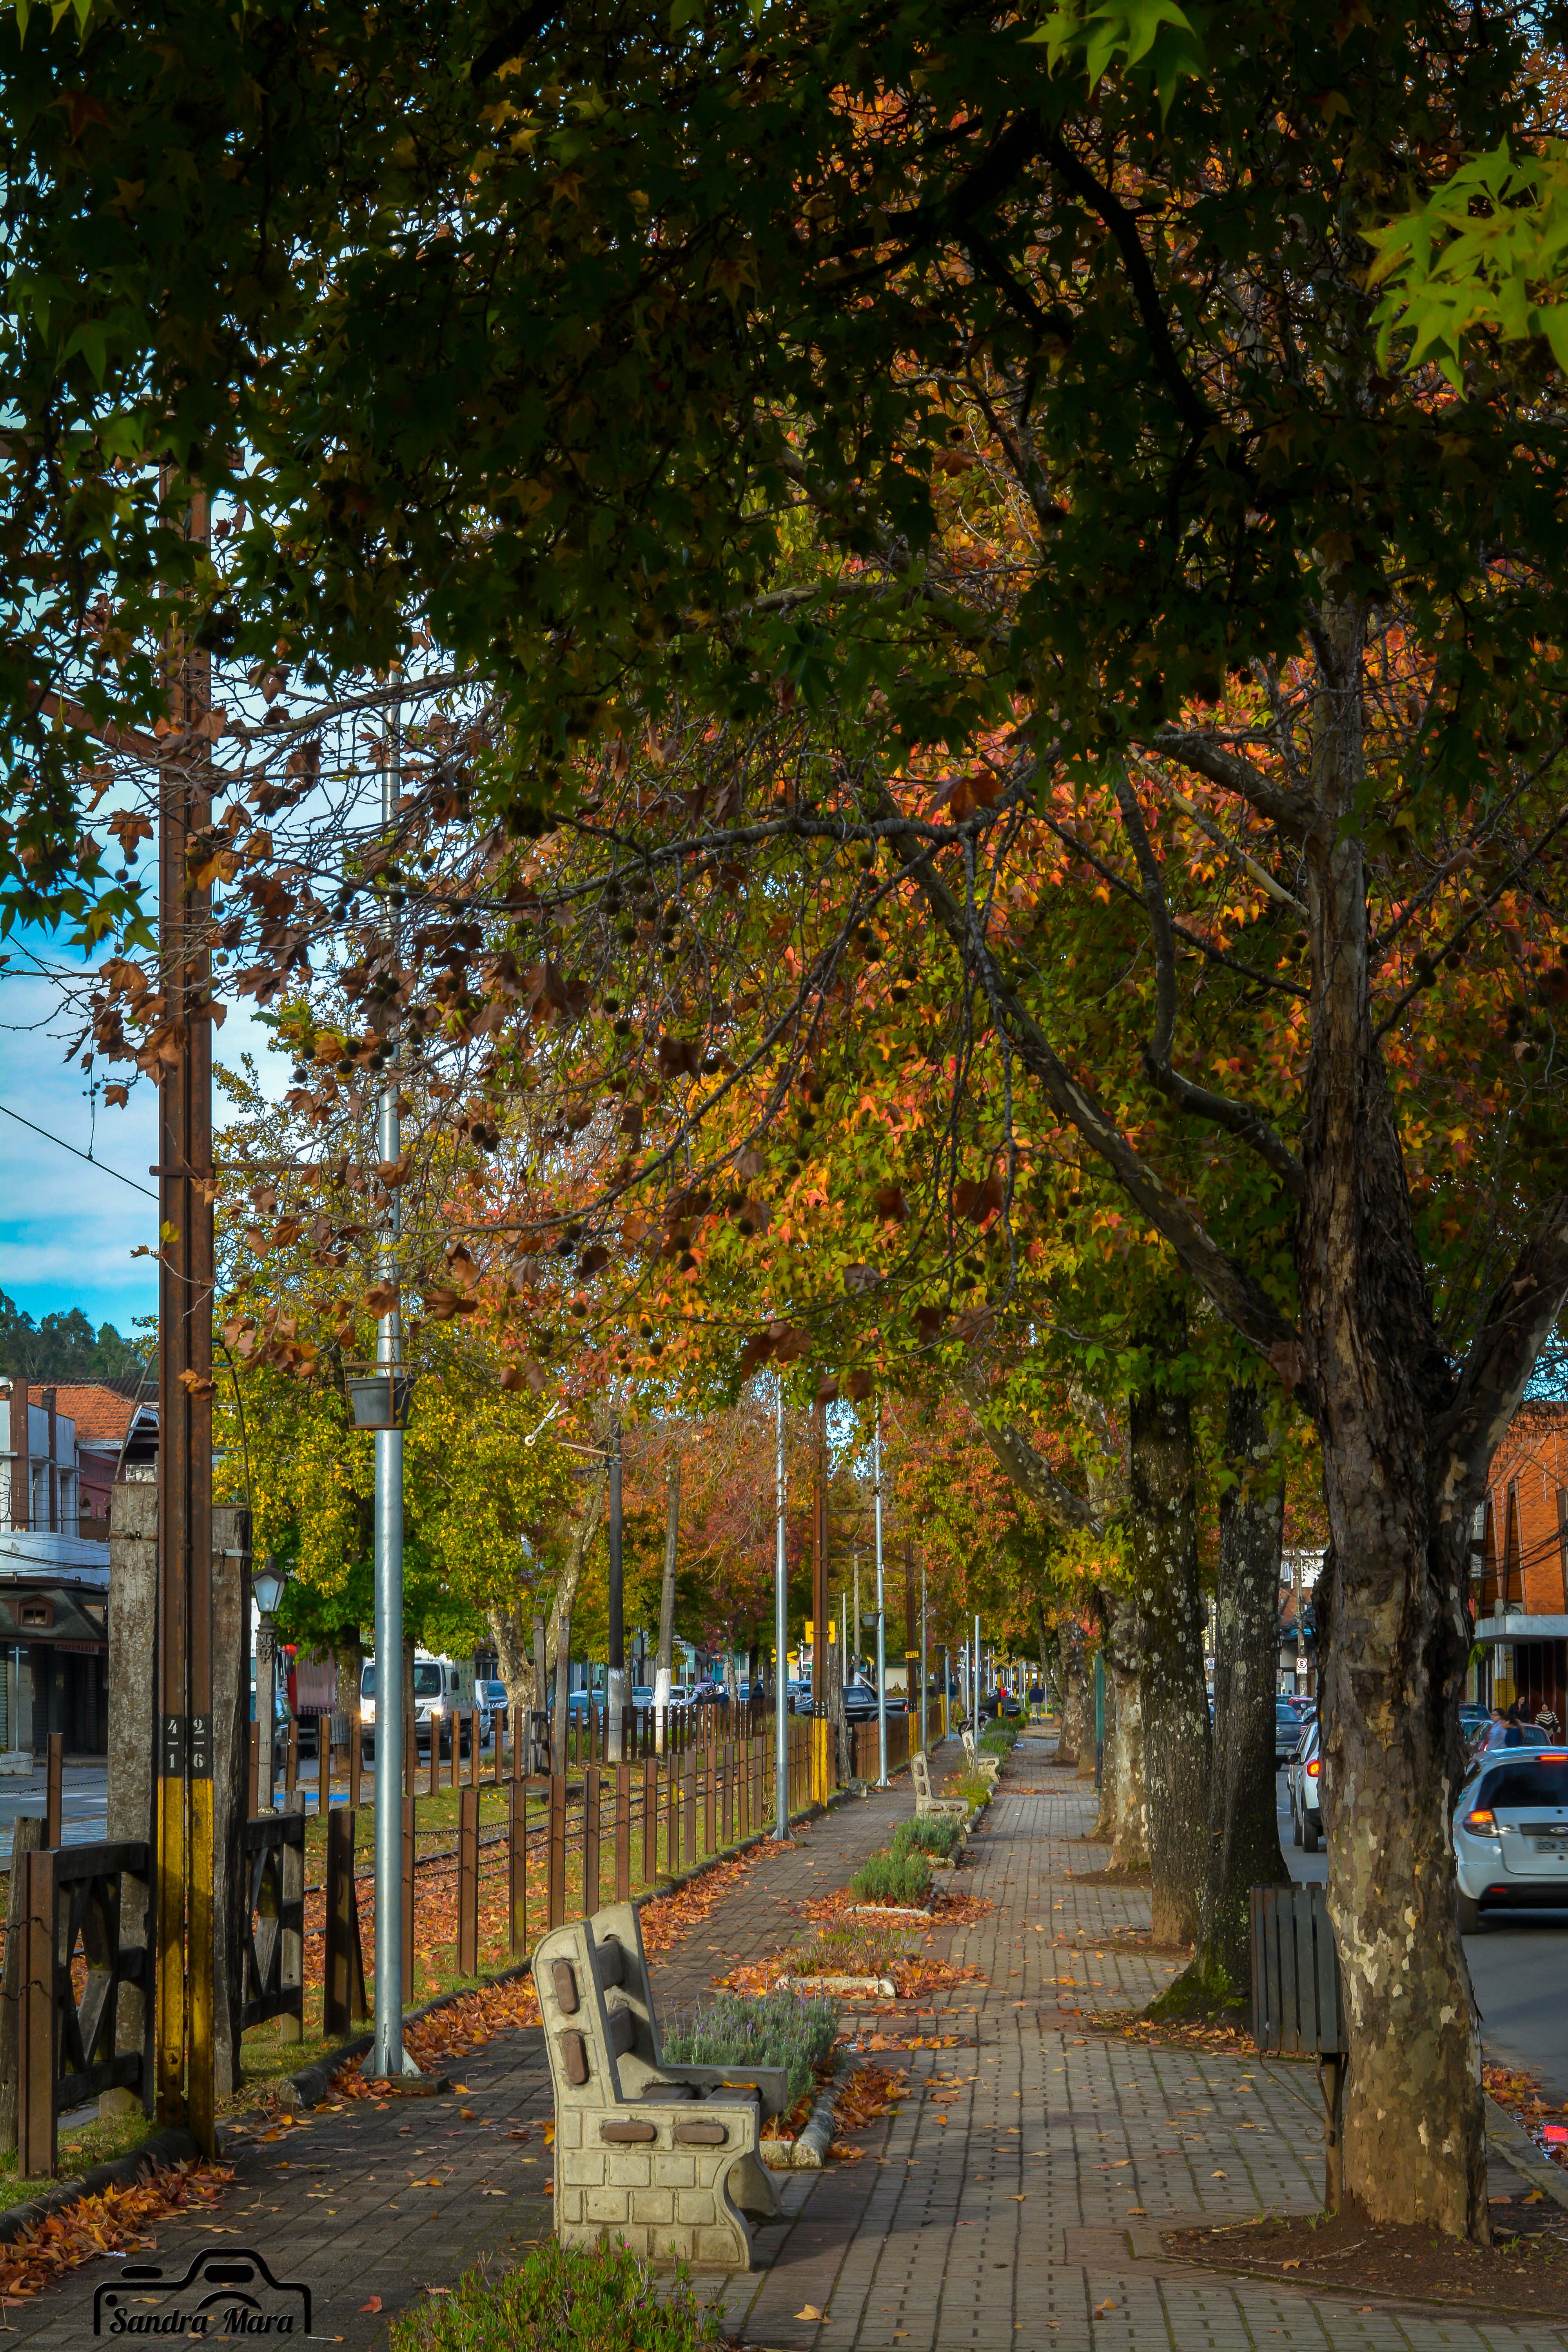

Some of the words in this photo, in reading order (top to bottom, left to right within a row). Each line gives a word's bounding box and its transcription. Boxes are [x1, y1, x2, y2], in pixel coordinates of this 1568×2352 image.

[168, 1720, 177, 1733] 4
[193, 1719, 204, 1734] 2
[169, 1753, 175, 1768] 1
[193, 1753, 203, 1768] 6
